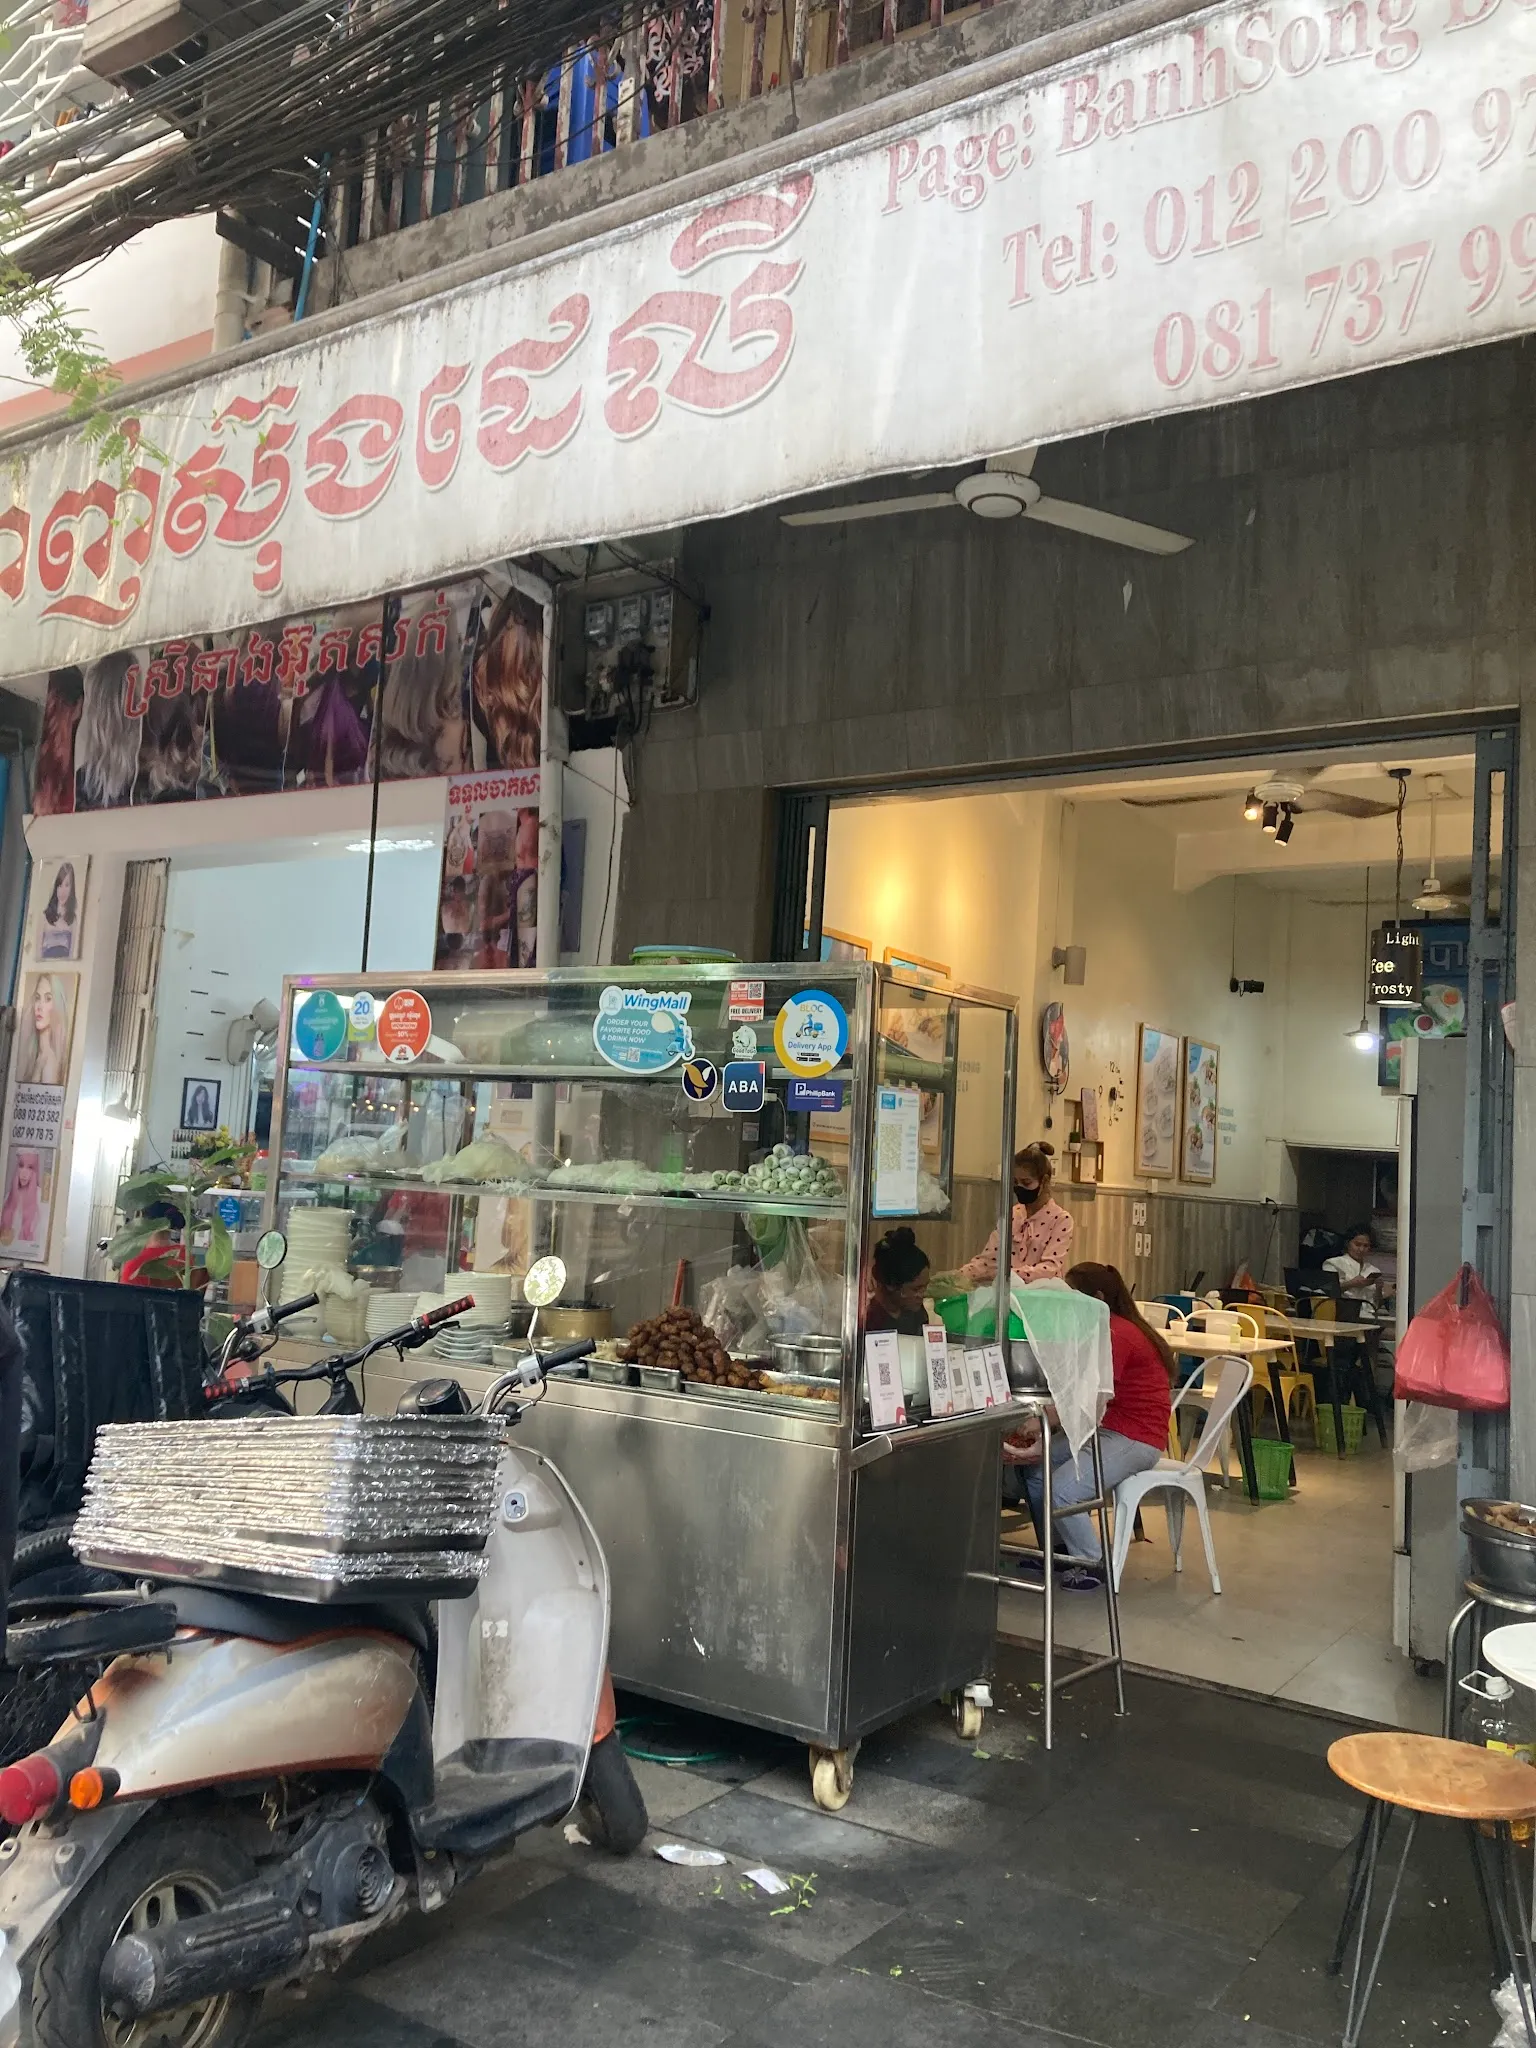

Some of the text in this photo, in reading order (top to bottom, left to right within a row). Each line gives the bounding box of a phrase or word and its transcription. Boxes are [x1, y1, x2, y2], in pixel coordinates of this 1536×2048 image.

[881, 0, 1422, 216] Page: BanhSong
[1003, 201, 1119, 309] Tel:
[1143, 160, 1263, 265] 012
[1289, 108, 1443, 225] 200
[1153, 287, 1281, 391] 081
[1304, 239, 1435, 358] 737
[354, 1001, 370, 1015] 20
[624, 993, 688, 1011] WingMall
[800, 1004, 824, 1013] BLOC
[606, 1018, 649, 1027] ORDER YOUR
[600, 1026, 652, 1036] FAVORITE FOOD
[607, 1034, 628, 1042] DRINK
[628, 1036, 647, 1044] NOW
[787, 1041, 832, 1052] Delivery App
[728, 1080, 759, 1093] ABA
